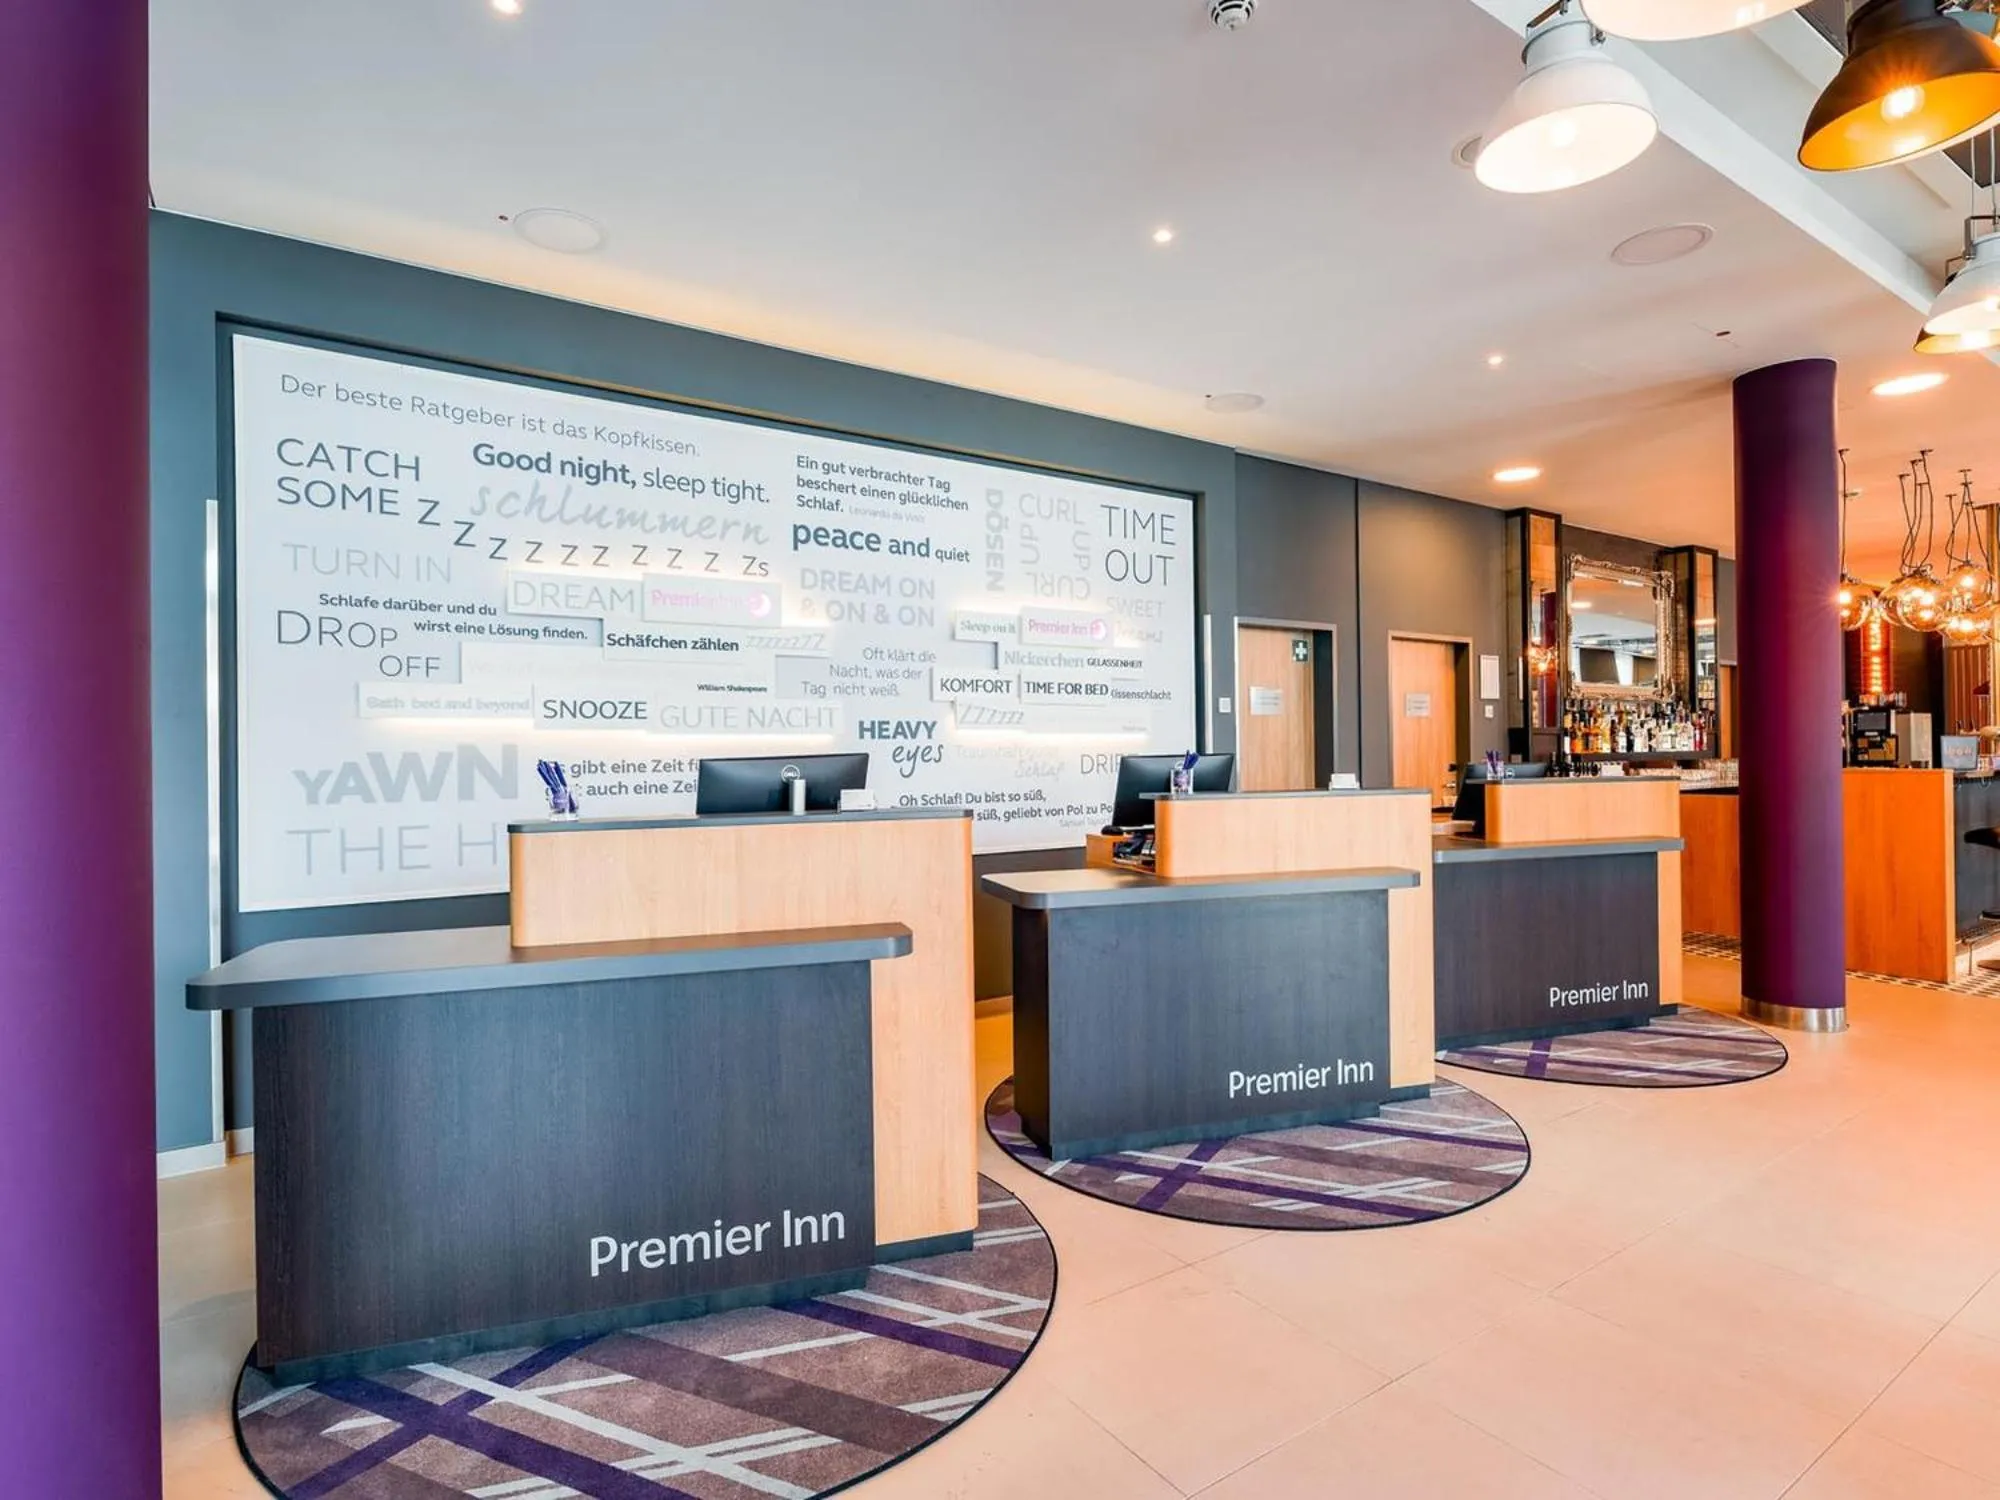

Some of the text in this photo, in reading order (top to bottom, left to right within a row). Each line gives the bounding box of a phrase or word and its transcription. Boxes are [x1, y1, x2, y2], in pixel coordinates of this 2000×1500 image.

[281, 374, 700, 457] Der beste Ratgeber ist das Kopfkissen.
[277, 438, 420, 482] CATCH
[473, 443, 770, 505] Good night, sleep tight.
[796, 455, 951, 493] Ein gut verbrachter Tag
[277, 476, 401, 516] SOME
[796, 475, 969, 511] beschert einen glücklichen
[796, 494, 844, 513] Schlaf.
[1018, 493, 1086, 525] CURL
[470, 478, 770, 547] schlummern
[1100, 503, 1176, 546] TIME
[793, 523, 970, 563] peace and quiet
[986, 488, 1009, 592] DÖSEN
[1020, 523, 1041, 564] UP
[1072, 530, 1091, 571] UP
[282, 542, 451, 583] TURN IN
[1105, 549, 1175, 586] OUT
[512, 580, 634, 613] DREAM
[801, 567, 935, 600] DREAM ON
[1026, 571, 1091, 601] CURL
[319, 593, 497, 616] Schlafe darüber und du
[825, 600, 865, 624] ON
[873, 603, 890, 625] &
[898, 606, 935, 627] ON
[277, 610, 398, 649] DROP
[414, 619, 588, 641] wirst eine Lösung finden.
[606, 633, 739, 653] Schäfchen zählen
[379, 655, 440, 678] OFF
[863, 647, 936, 664] Oft klärt die
[875, 668, 899, 680] was
[902, 665, 923, 680] der
[940, 678, 1012, 694] KOMFORT
[1024, 680, 1109, 696] TIME FOR BED
[801, 680, 827, 699] Tag
[833, 682, 865, 697] nicht
[543, 699, 648, 720] SNOOZE
[660, 705, 837, 729] GUTE NACHT
[858, 720, 938, 740] HEAVY
[291, 743, 519, 806] YAWN
[570, 759, 606, 778] gibt
[611, 760, 647, 774] eine
[651, 759, 683, 774] Zeit
[891, 744, 944, 779] eyes
[586, 780, 629, 796] auch
[633, 779, 669, 795] eine
[672, 778, 697, 794] Zei
[899, 789, 1047, 807] Oh Schlaf! Du bist so süß,
[976, 803, 1113, 822] süß, geliebt von Pol zu Po
[286, 825, 432, 876] THE
[1549, 979, 1649, 1008] Premier Inn
[1229, 1058, 1374, 1099] Premier Inn
[590, 1209, 845, 1277] Premier Inn
